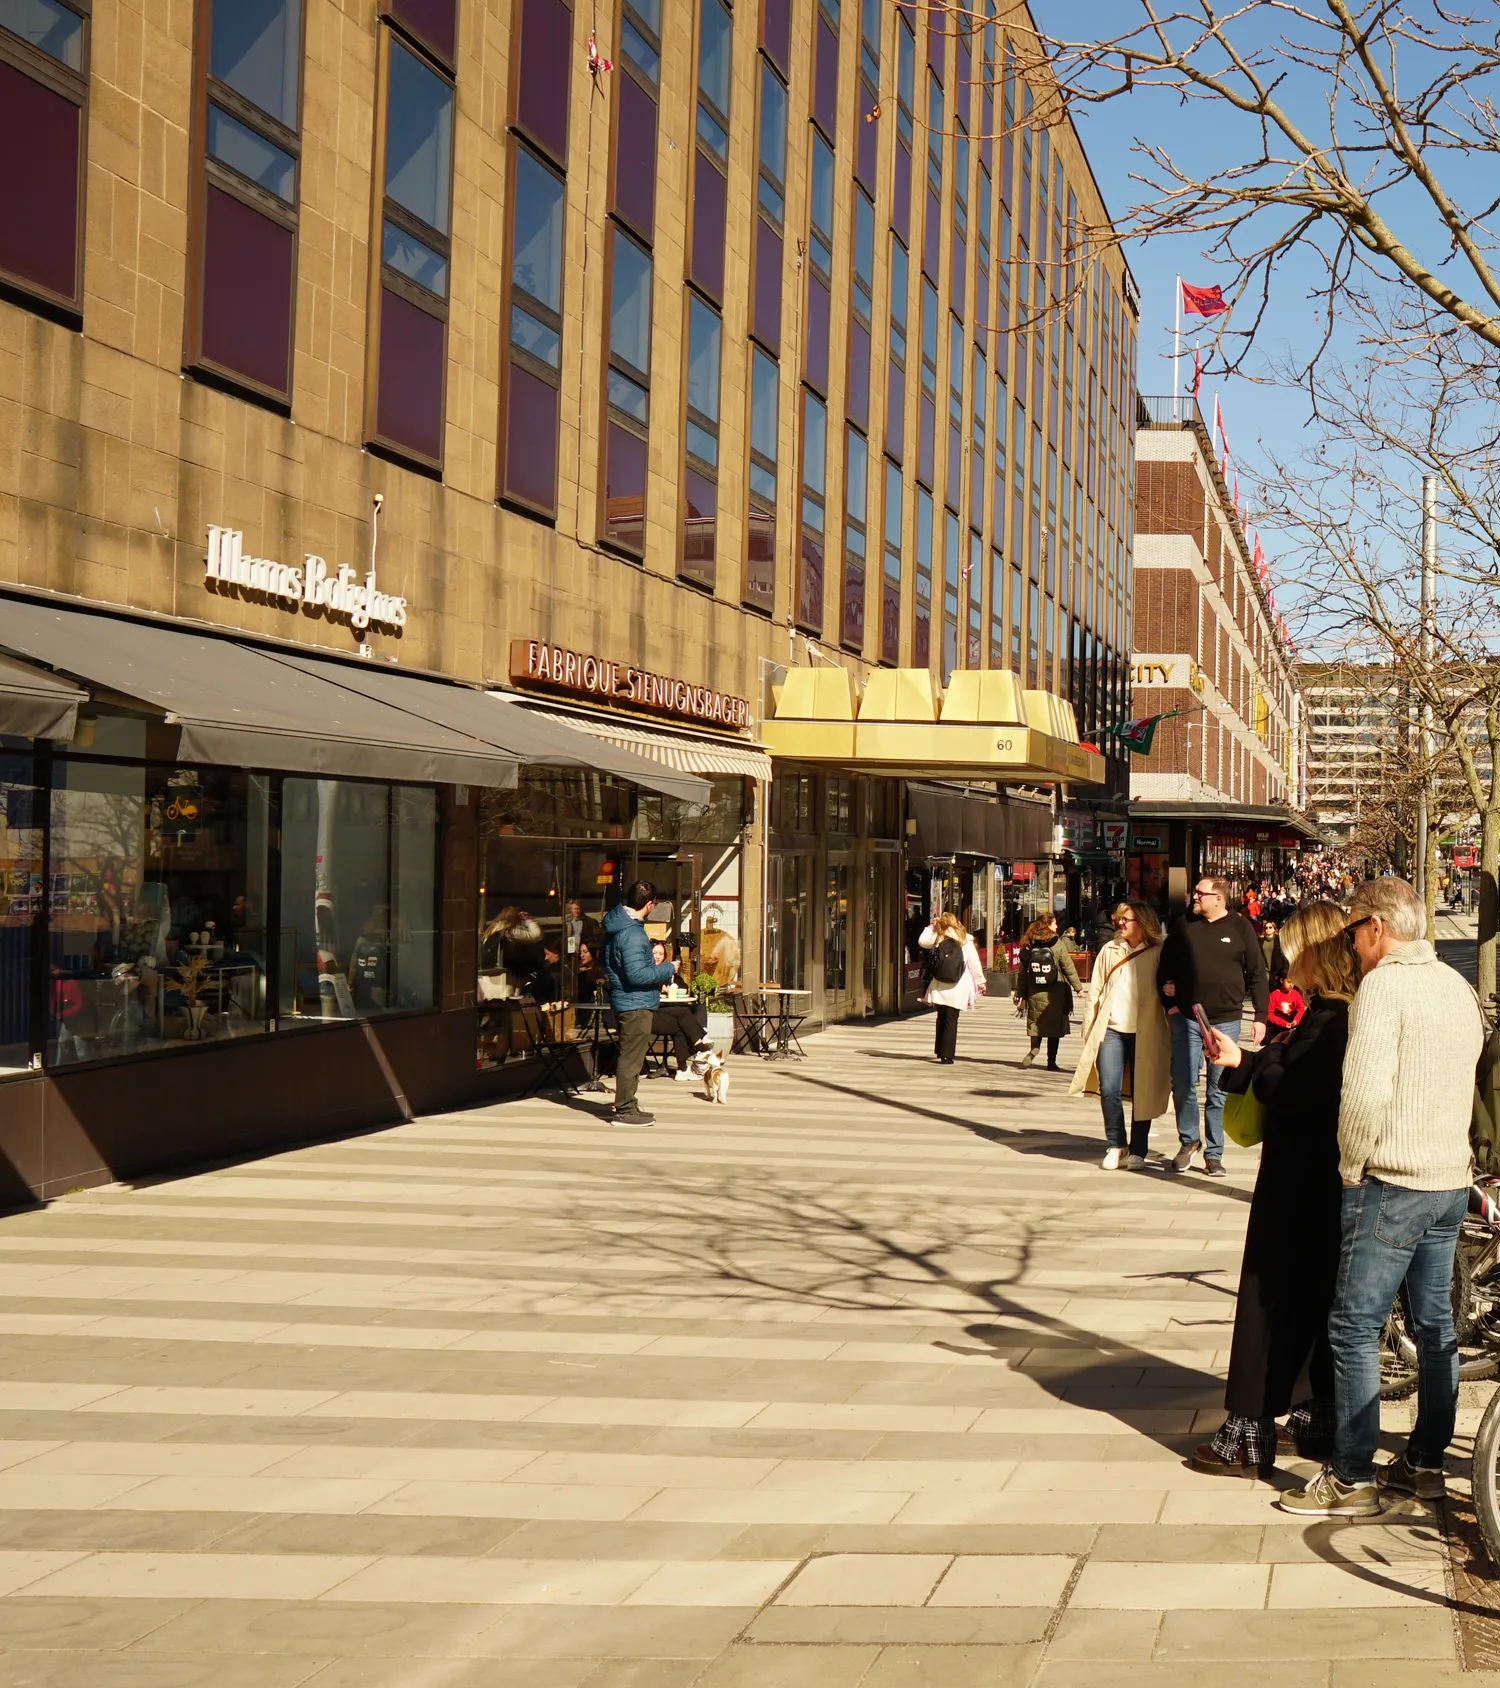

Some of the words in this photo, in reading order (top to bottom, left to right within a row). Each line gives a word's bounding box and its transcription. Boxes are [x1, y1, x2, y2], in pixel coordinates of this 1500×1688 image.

[204, 523, 303, 600] Illums
[302, 553, 407, 629] Bolighus
[528, 643, 619, 696] FABRIQUE
[626, 669, 750, 728] STENUGNSBAGERI
[996, 739, 1013, 751] 60
[1107, 825, 1125, 849] 7
[1136, 836, 1157, 846] Normal
[1314, 1484, 1337, 1506] N
